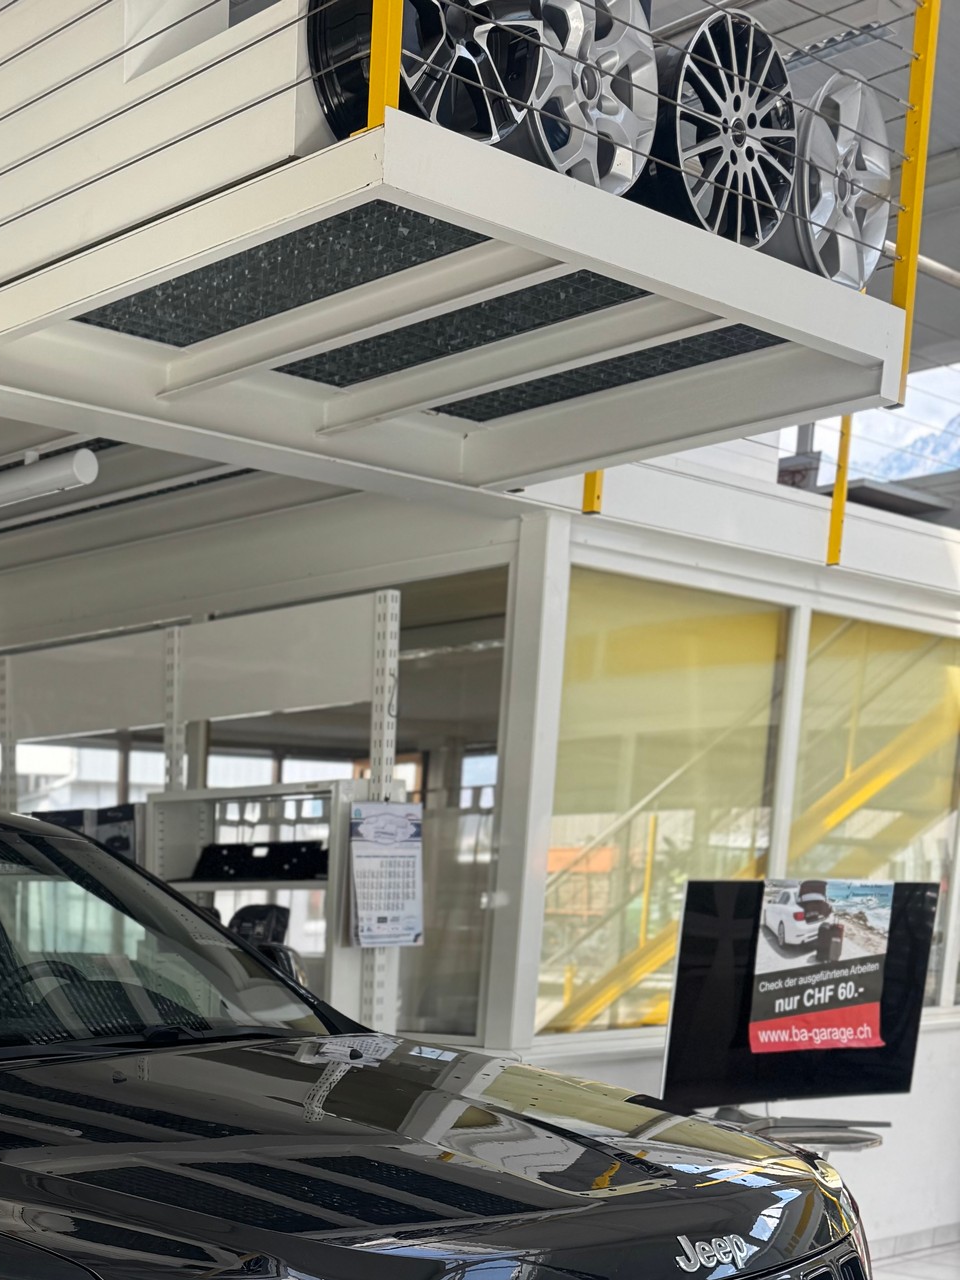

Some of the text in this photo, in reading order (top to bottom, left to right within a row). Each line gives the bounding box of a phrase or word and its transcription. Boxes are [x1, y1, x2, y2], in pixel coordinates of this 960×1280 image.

[758, 979, 784, 993] Check
[784, 977, 798, 989] der
[849, 962, 880, 975] Arbeiten
[774, 980, 865, 1013] nur CHF 60.-
[757, 1023, 872, 1043] www.ba-garage.ch
[675, 1234, 748, 1273] Jeep
